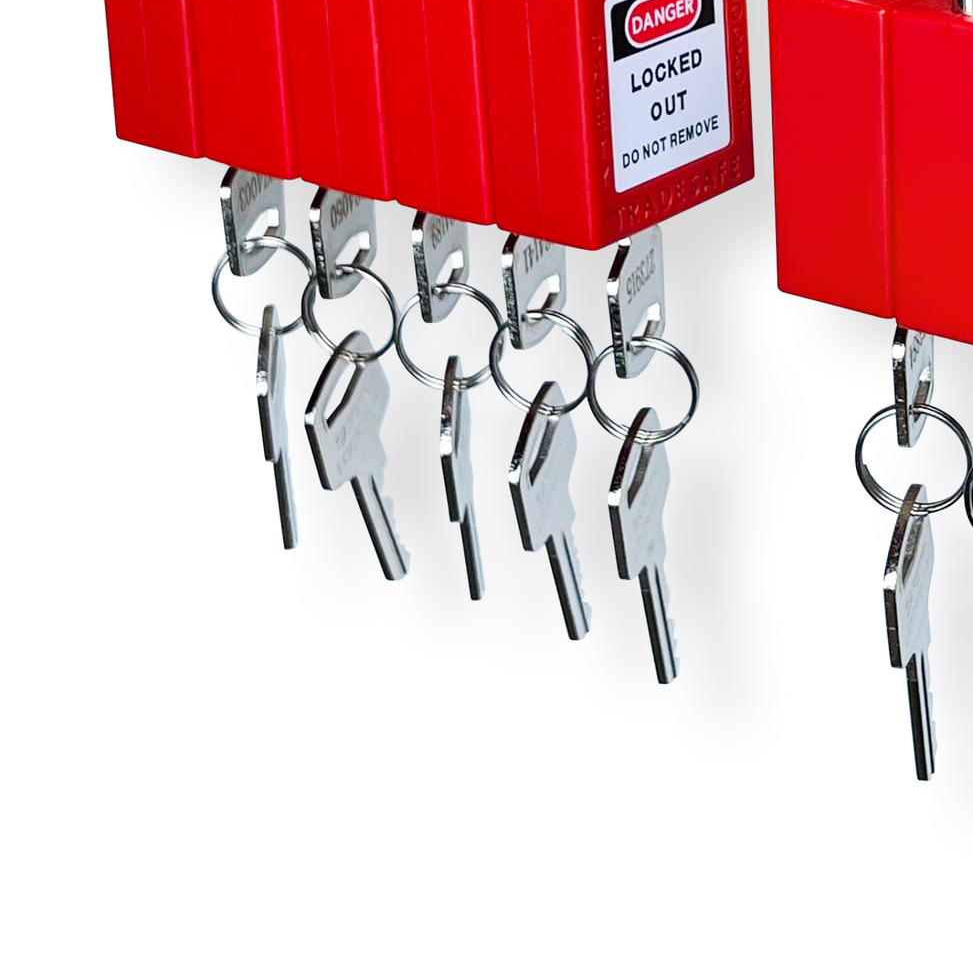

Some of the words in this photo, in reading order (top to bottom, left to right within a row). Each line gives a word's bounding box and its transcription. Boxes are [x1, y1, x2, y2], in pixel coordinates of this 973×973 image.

[630, 48, 703, 94] LOCKED
[650, 89, 688, 122] OUT
[622, 148, 640, 169] DO
[643, 136, 667, 160] NOT
[670, 114, 719, 148] REMOVE
[613, 155, 742, 231] TRADESAFE
